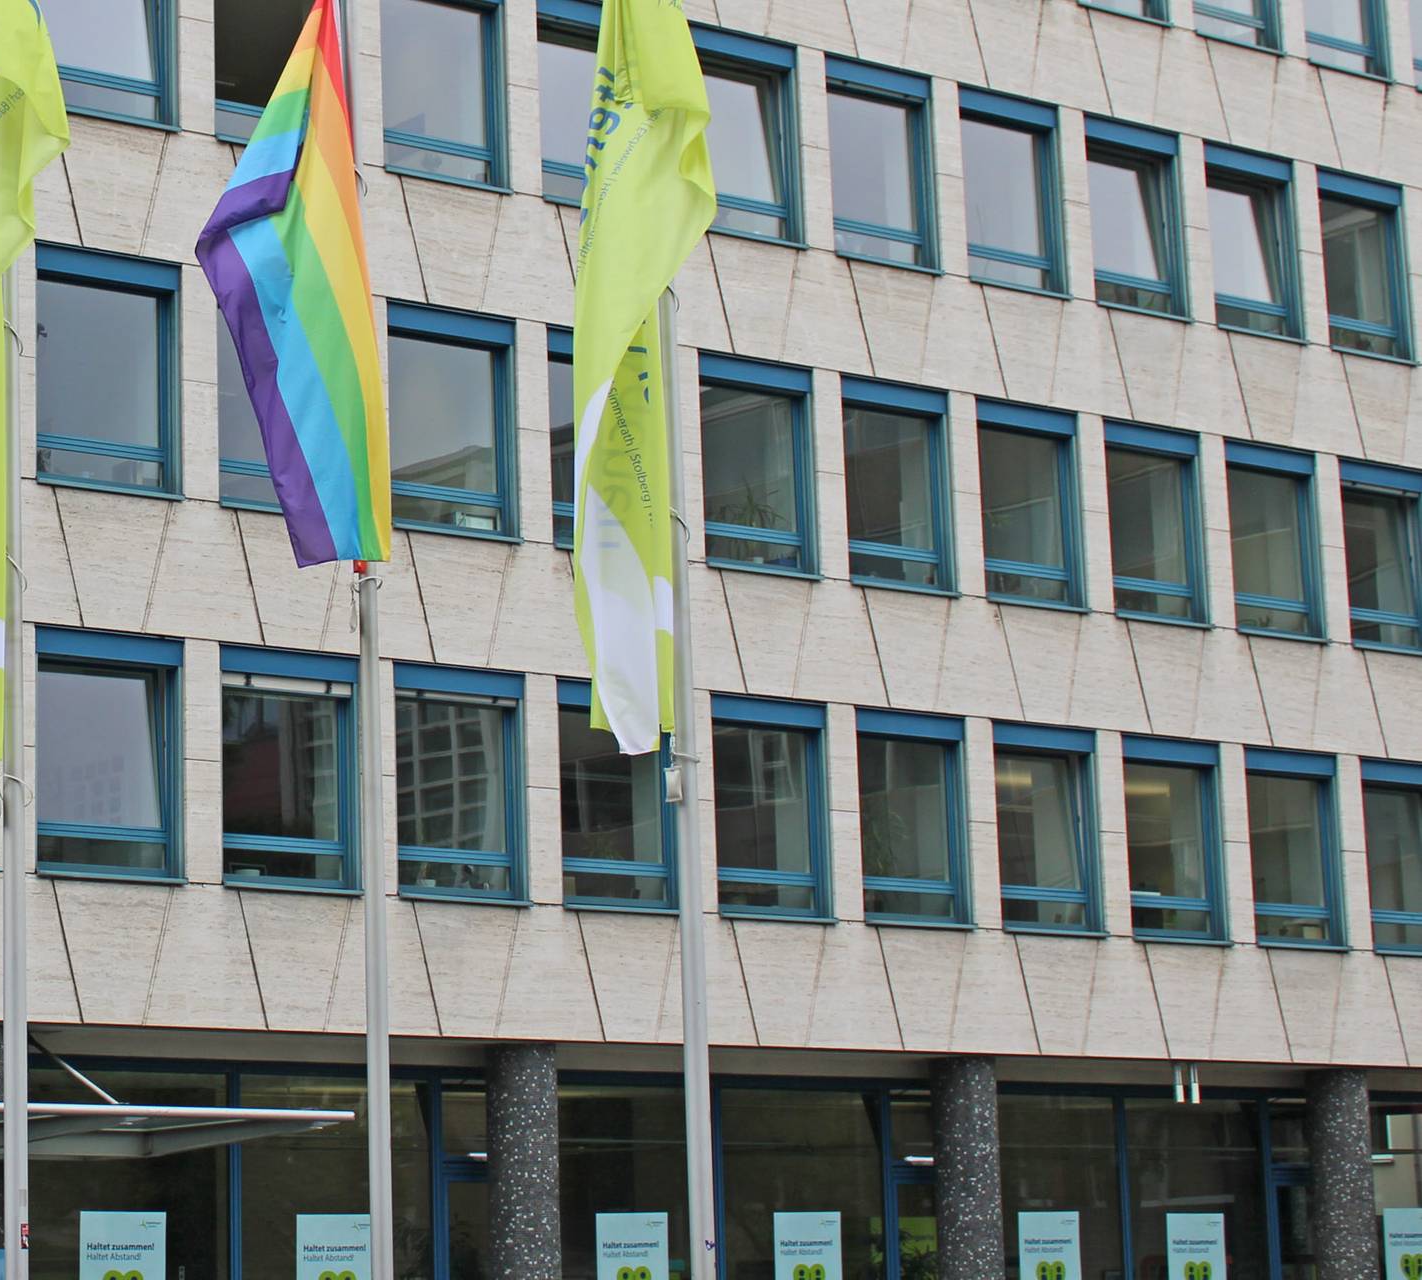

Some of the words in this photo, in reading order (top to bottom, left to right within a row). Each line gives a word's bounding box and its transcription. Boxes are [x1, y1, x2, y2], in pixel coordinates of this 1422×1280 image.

[608, 387, 635, 448] Simmerath
[630, 453, 651, 503] Stolberg
[86, 1242, 111, 1250] Haltet
